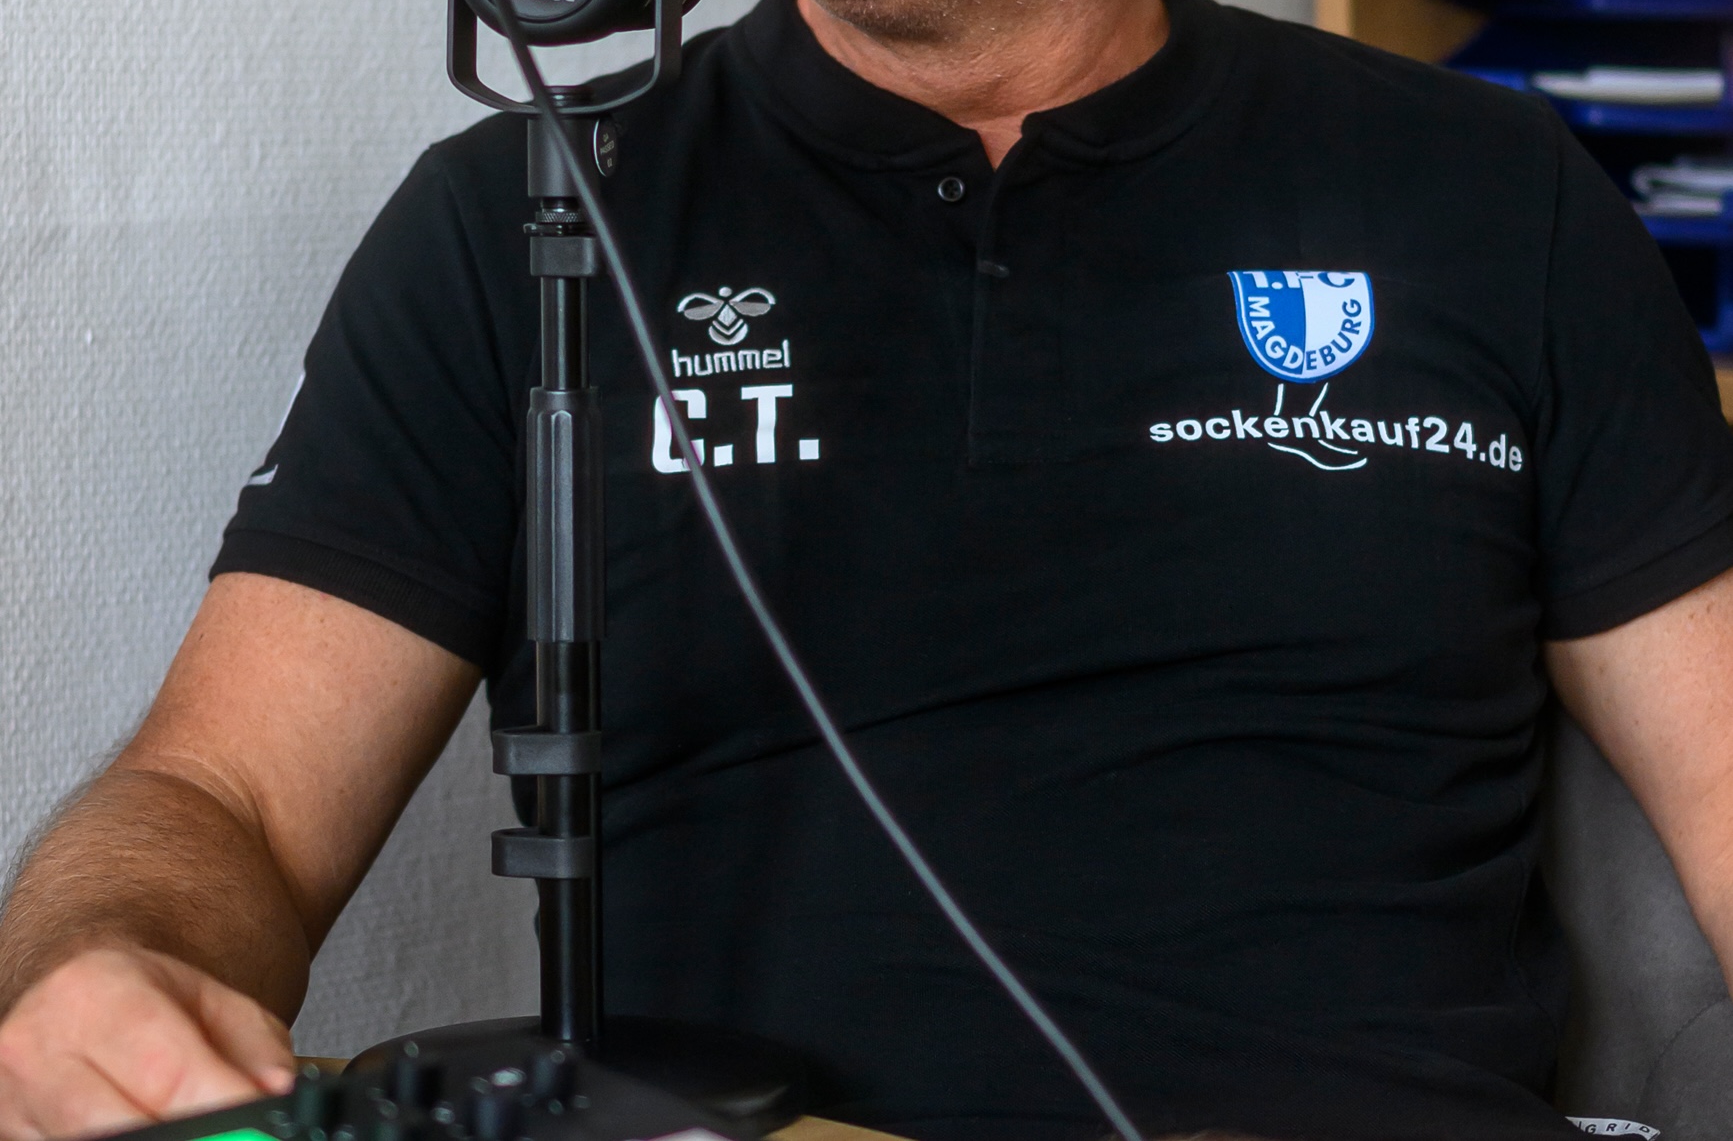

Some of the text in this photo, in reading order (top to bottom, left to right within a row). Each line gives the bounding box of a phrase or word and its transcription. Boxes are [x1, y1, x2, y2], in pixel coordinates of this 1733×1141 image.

[671, 339, 792, 378] hummel
[1247, 295, 1363, 375] MAGDEBURG
[651, 383, 821, 475] C.T.
[1149, 409, 1523, 472] sockenkauf24.de
